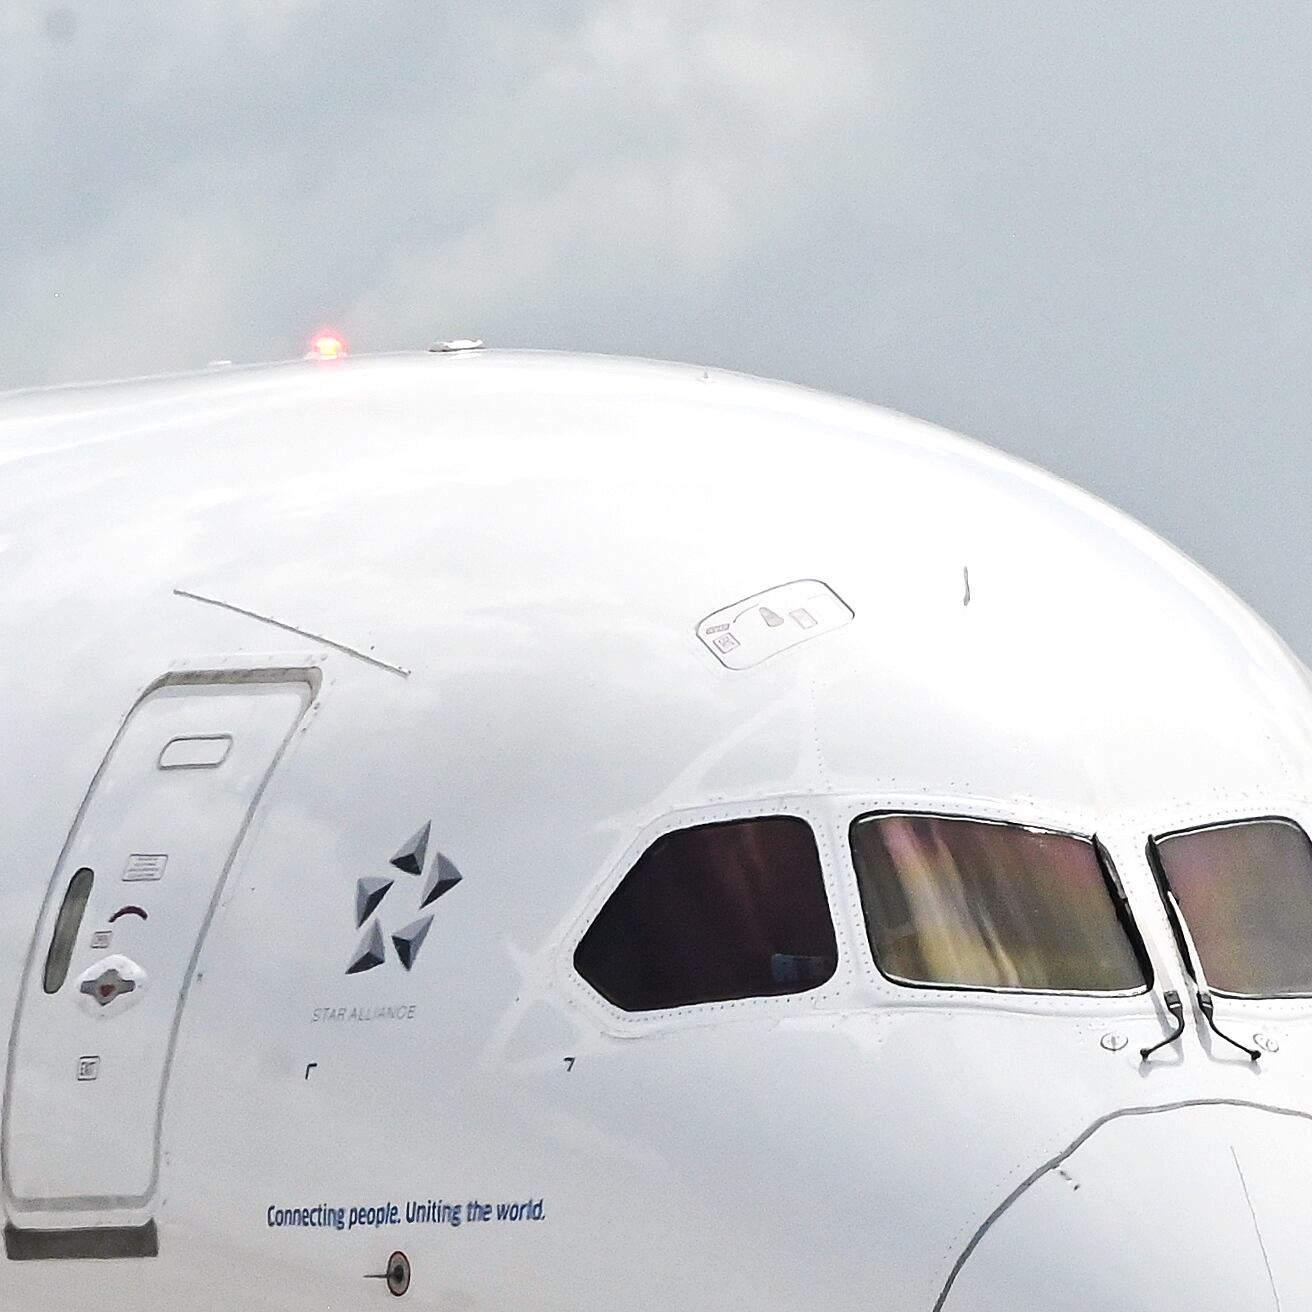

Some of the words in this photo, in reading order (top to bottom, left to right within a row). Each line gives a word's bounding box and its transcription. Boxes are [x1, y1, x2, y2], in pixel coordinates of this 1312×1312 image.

[311, 1007, 346, 1022] STAR
[350, 1004, 416, 1021] ALLIANCE
[267, 1203, 345, 1230] Connecting
[349, 1203, 401, 1229] people.
[405, 1200, 461, 1226] Uniting
[466, 1199, 492, 1222] the
[496, 1198, 546, 1221] world.
